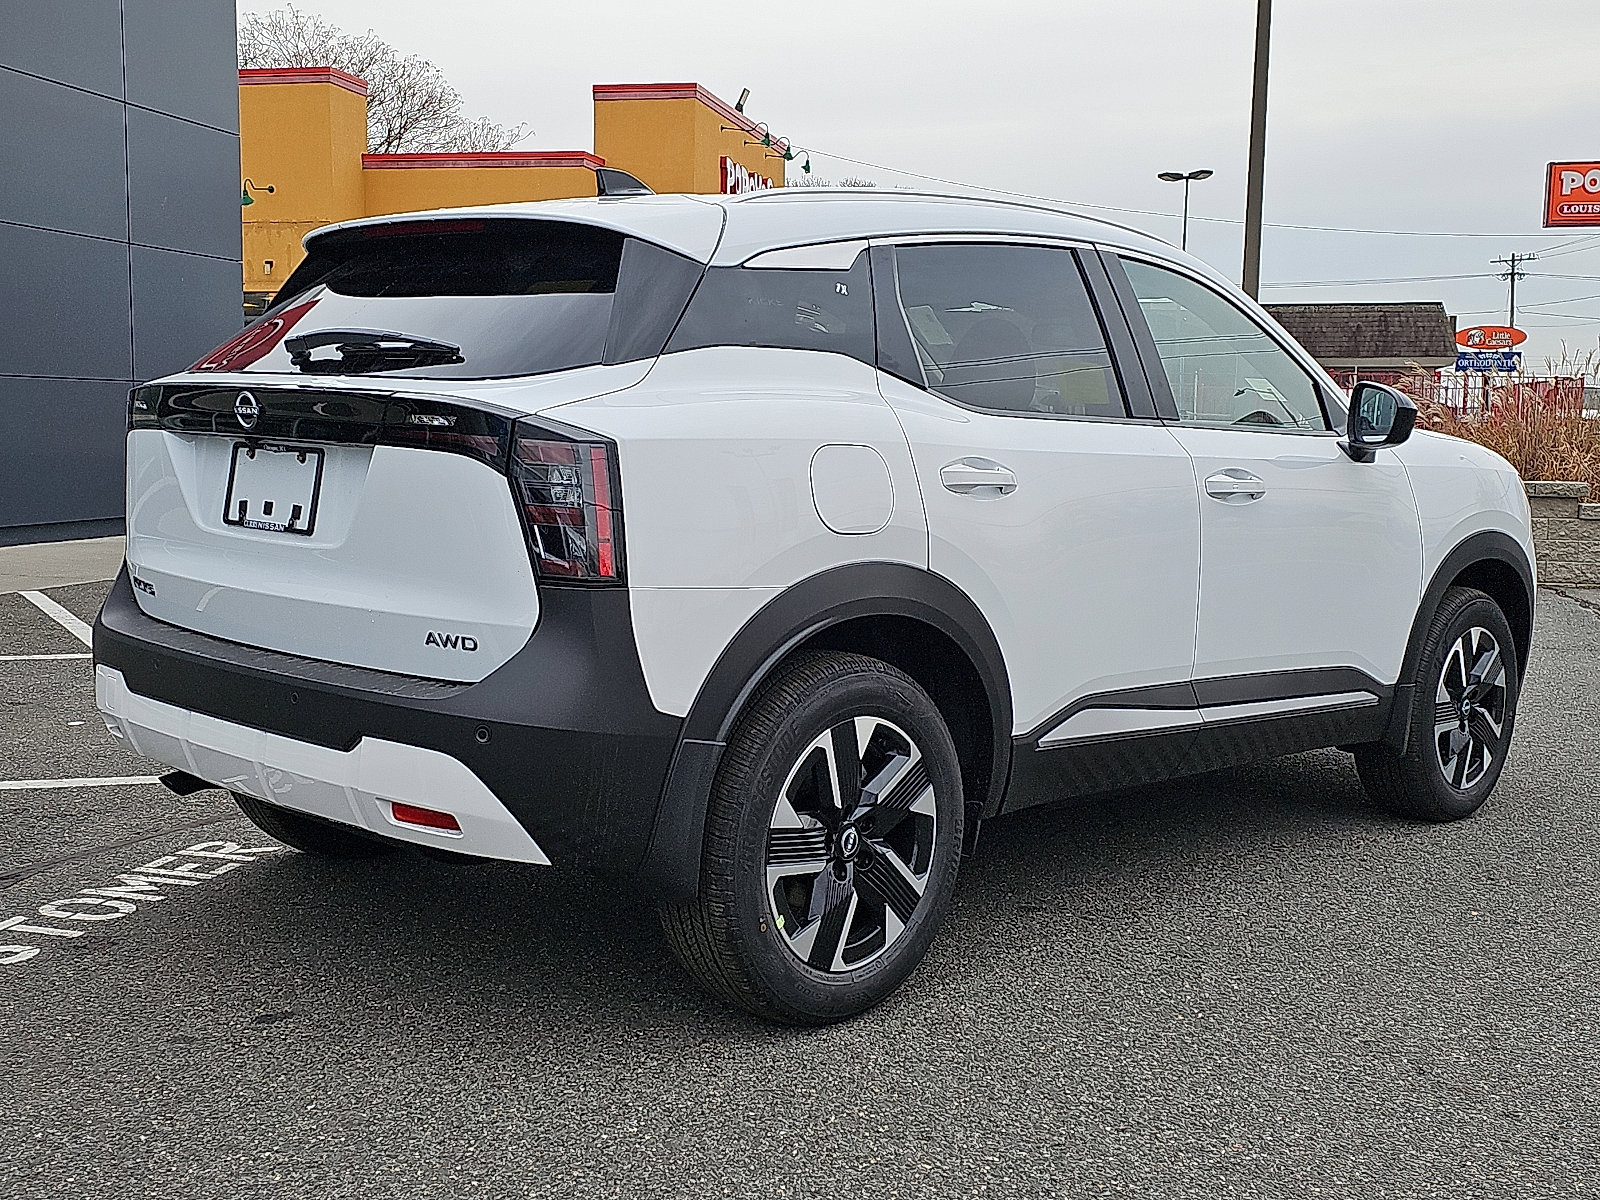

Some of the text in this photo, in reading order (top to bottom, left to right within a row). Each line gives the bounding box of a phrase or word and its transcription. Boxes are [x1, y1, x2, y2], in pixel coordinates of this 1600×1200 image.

[1562, 204, 1600, 213] LOUIS
[1492, 331, 1511, 339] Little
[1486, 338, 1513, 346] Caesars
[424, 631, 479, 651] AWD
